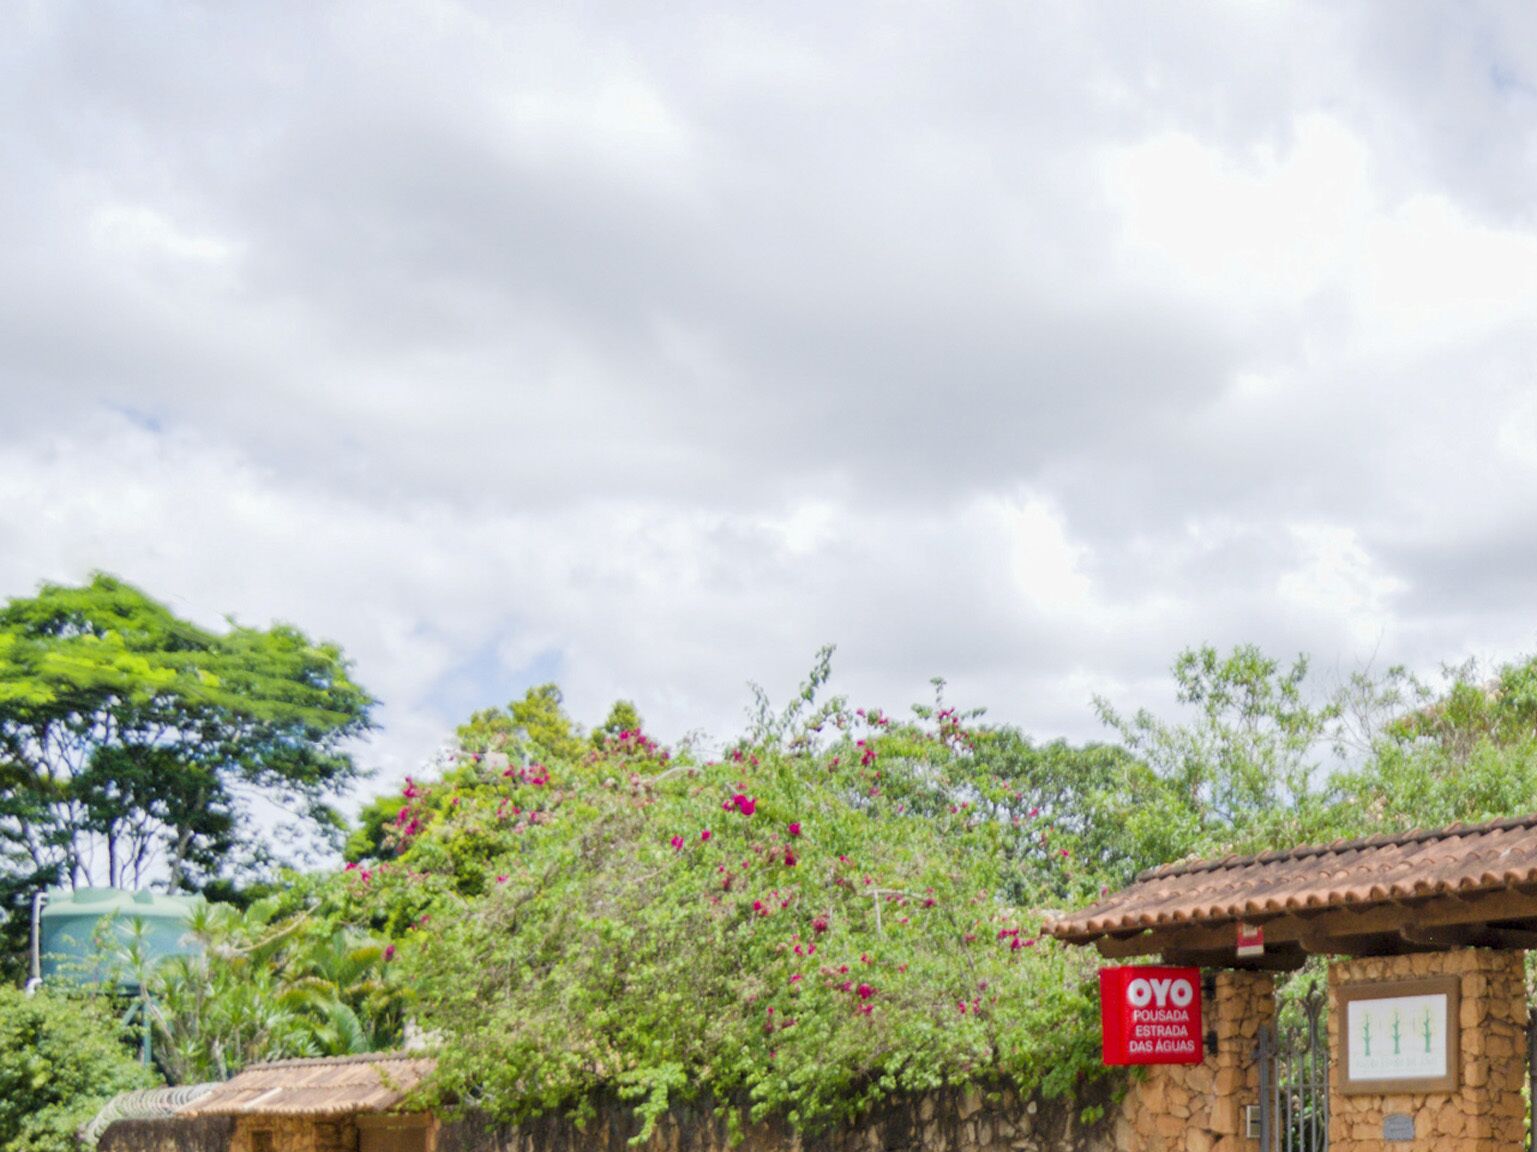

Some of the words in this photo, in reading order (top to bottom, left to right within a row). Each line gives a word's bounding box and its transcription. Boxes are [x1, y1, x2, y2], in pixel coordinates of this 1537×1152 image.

[1127, 978, 1193, 1007] OYO
[1132, 1009, 1189, 1022] POUSADA
[1135, 1025, 1188, 1037] ESTRADA
[1129, 1040, 1153, 1054] DAS
[1155, 1038, 1195, 1053] ÁGUAS
